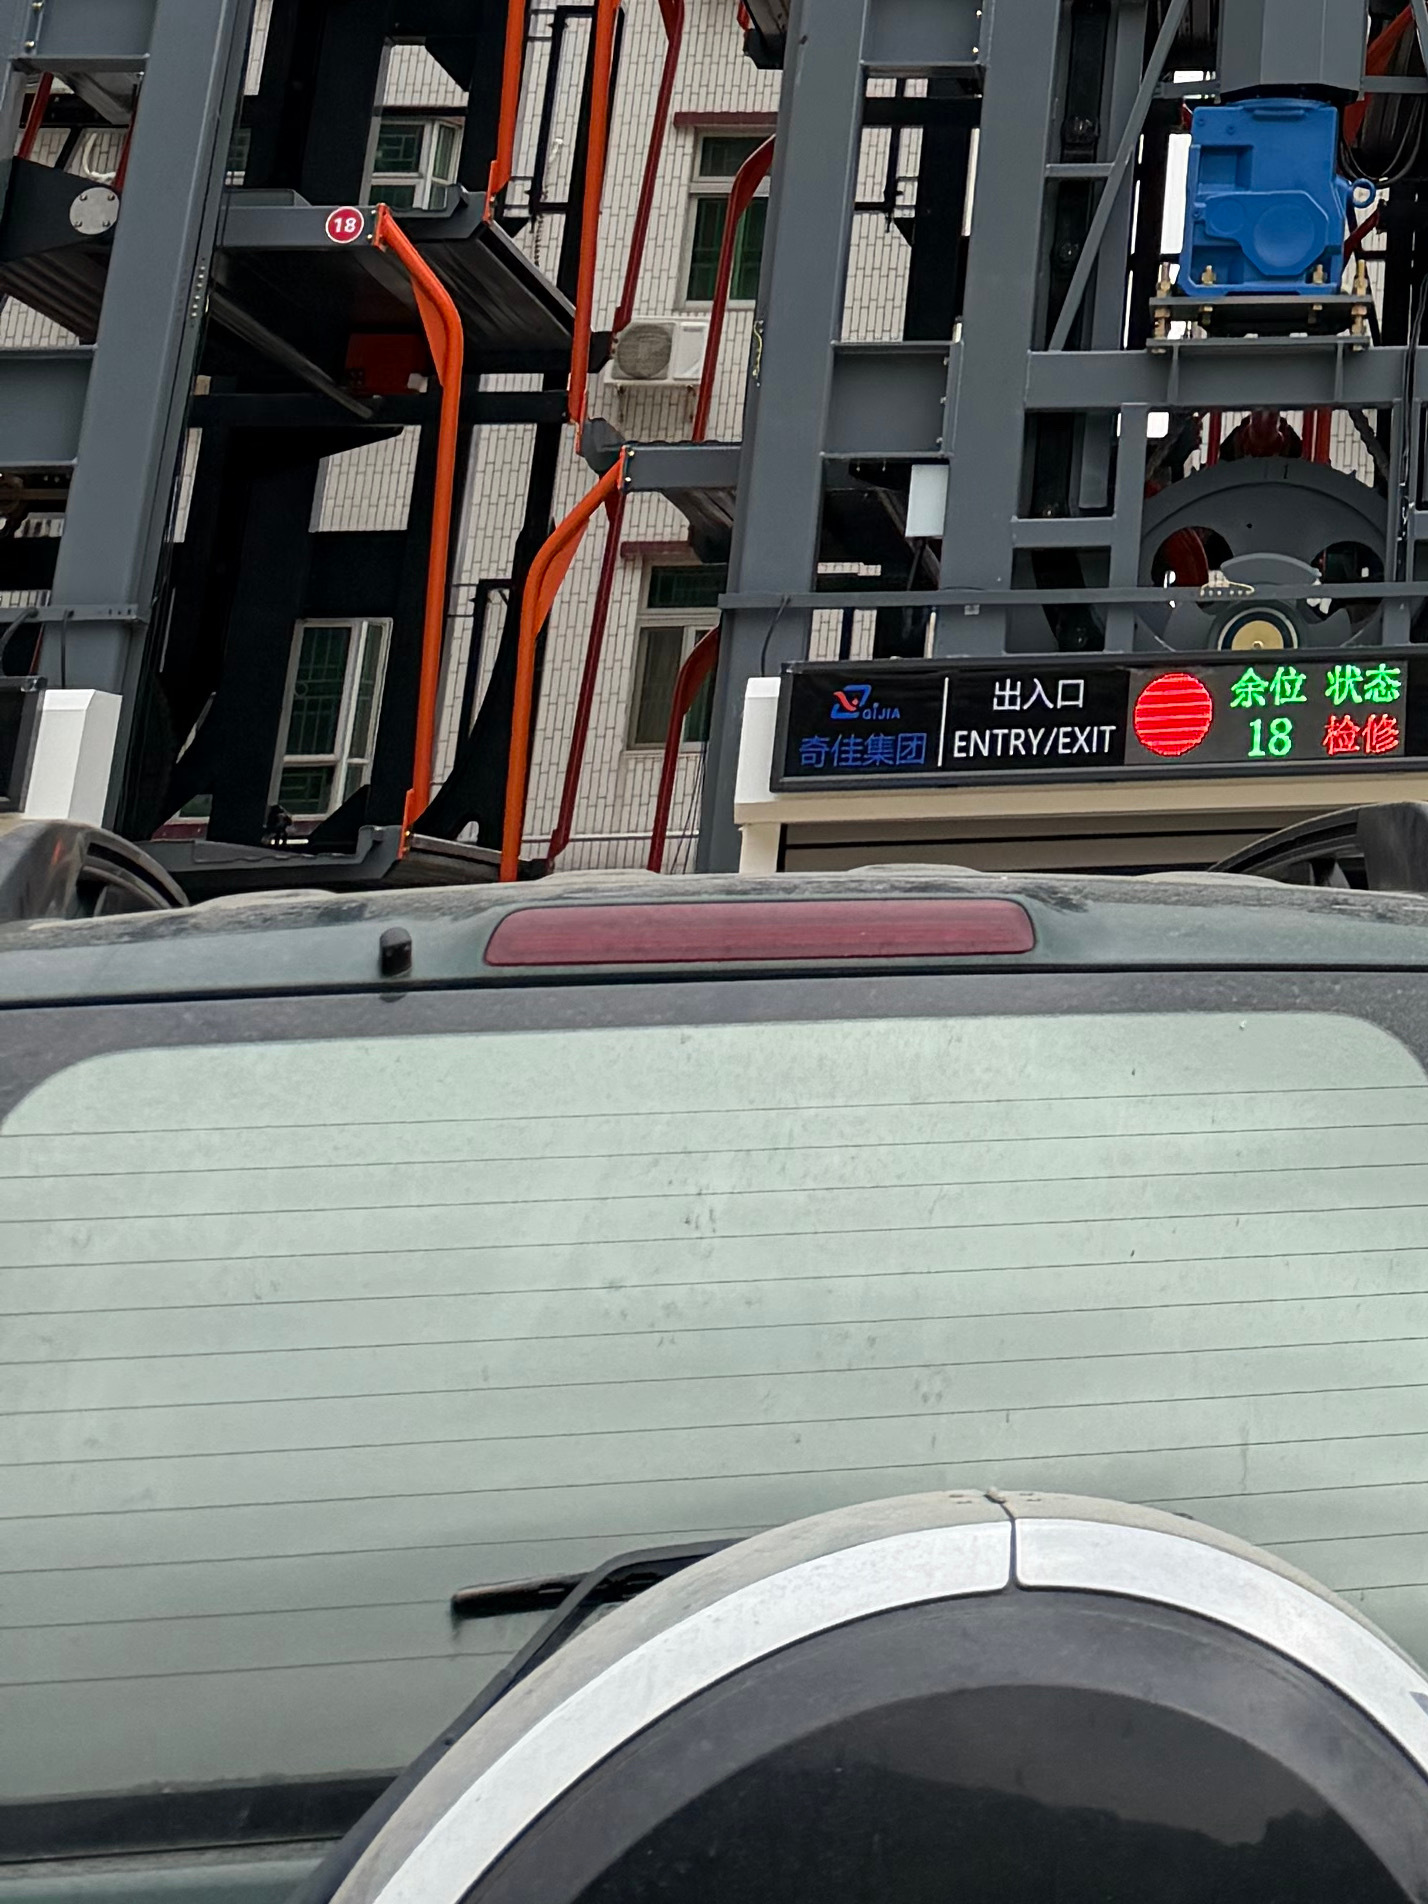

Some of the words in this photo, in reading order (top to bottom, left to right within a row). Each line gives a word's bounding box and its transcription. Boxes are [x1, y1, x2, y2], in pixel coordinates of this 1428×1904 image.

[335, 216, 356, 235] 18
[993, 678, 1084, 710] 出入口
[1230, 665, 1307, 709] 余位
[1325, 662, 1401, 706] 状态
[799, 732, 927, 769] 奇佳集团
[953, 726, 1116, 758] ENTRY/EXIT
[1248, 717, 1293, 758] 18
[1322, 714, 1400, 756] 检修
